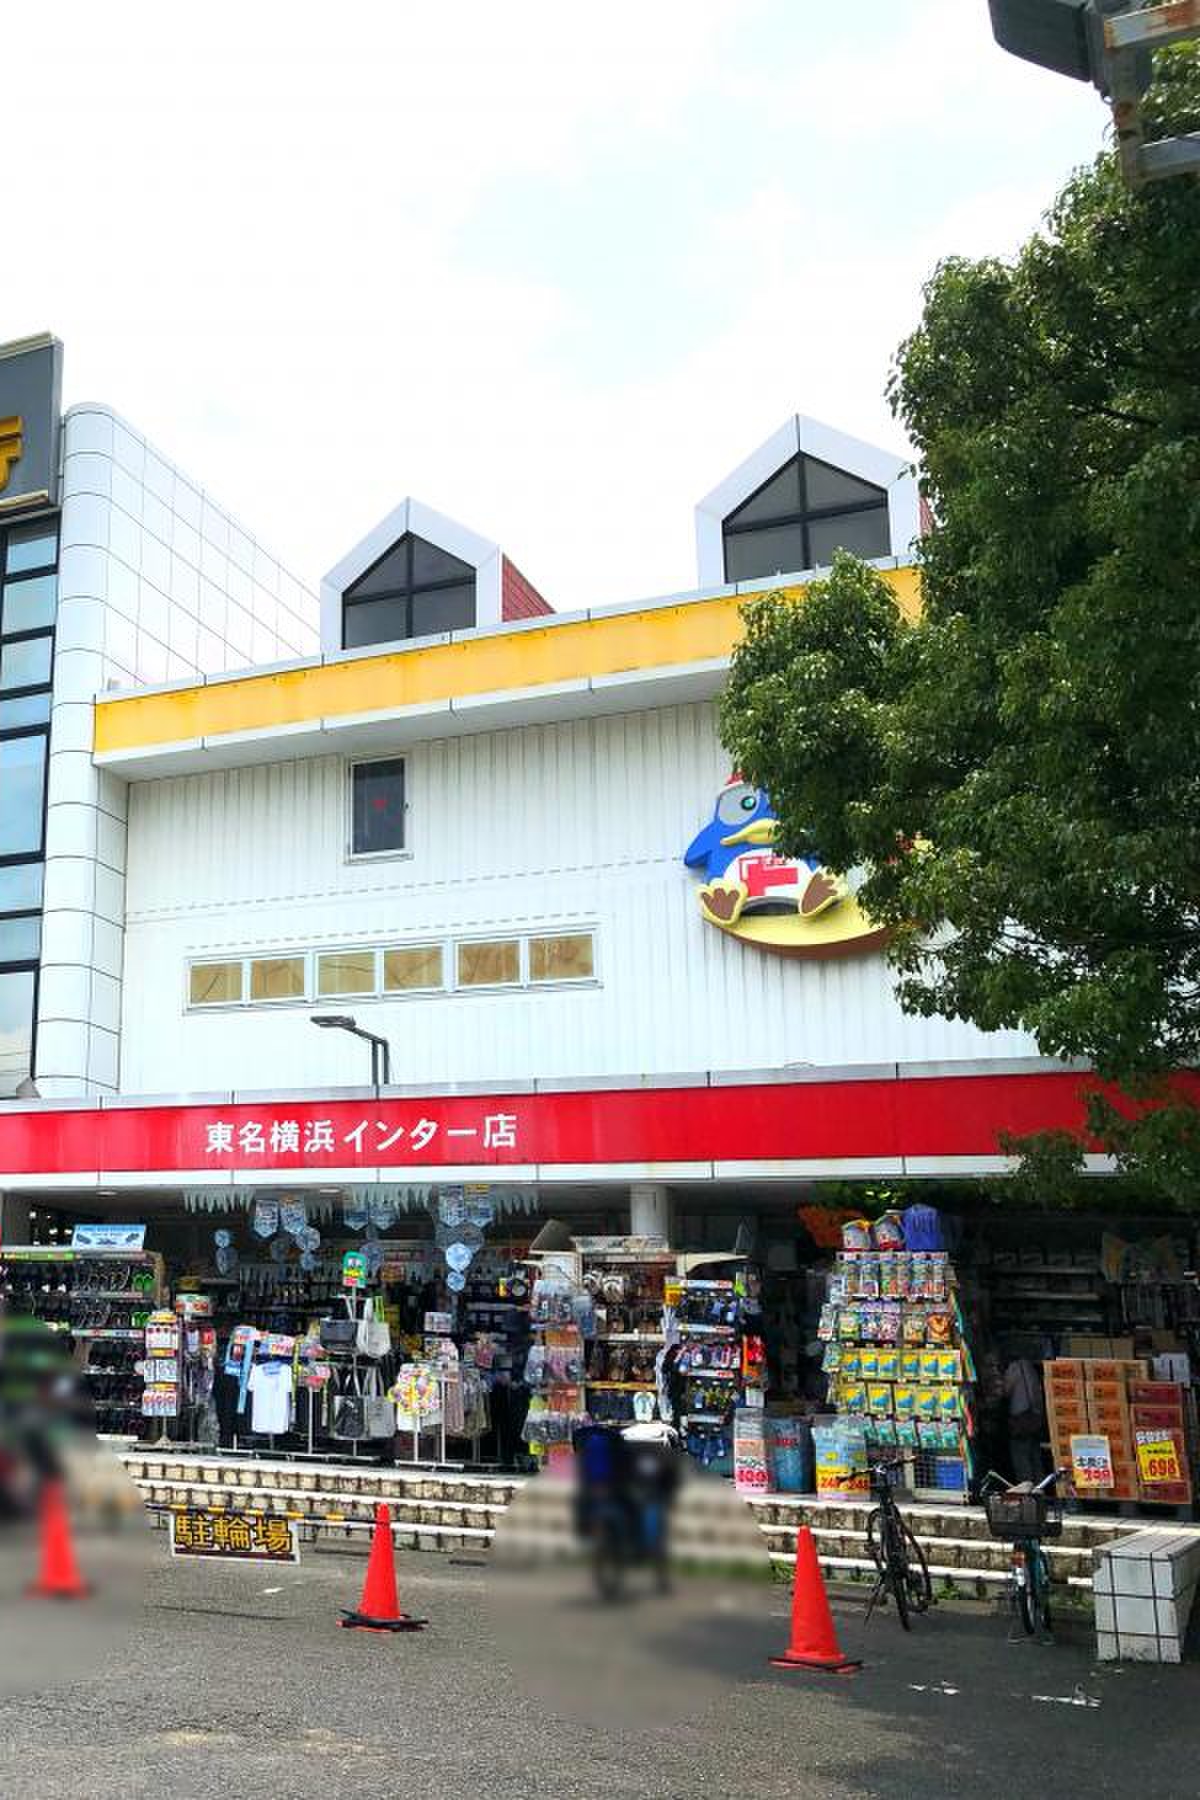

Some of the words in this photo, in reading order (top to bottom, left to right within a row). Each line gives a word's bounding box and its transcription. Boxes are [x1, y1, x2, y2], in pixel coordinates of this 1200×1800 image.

[205, 1113, 518, 1153] 東名横浜インター店
[173, 1513, 293, 1553] 駐輪場
